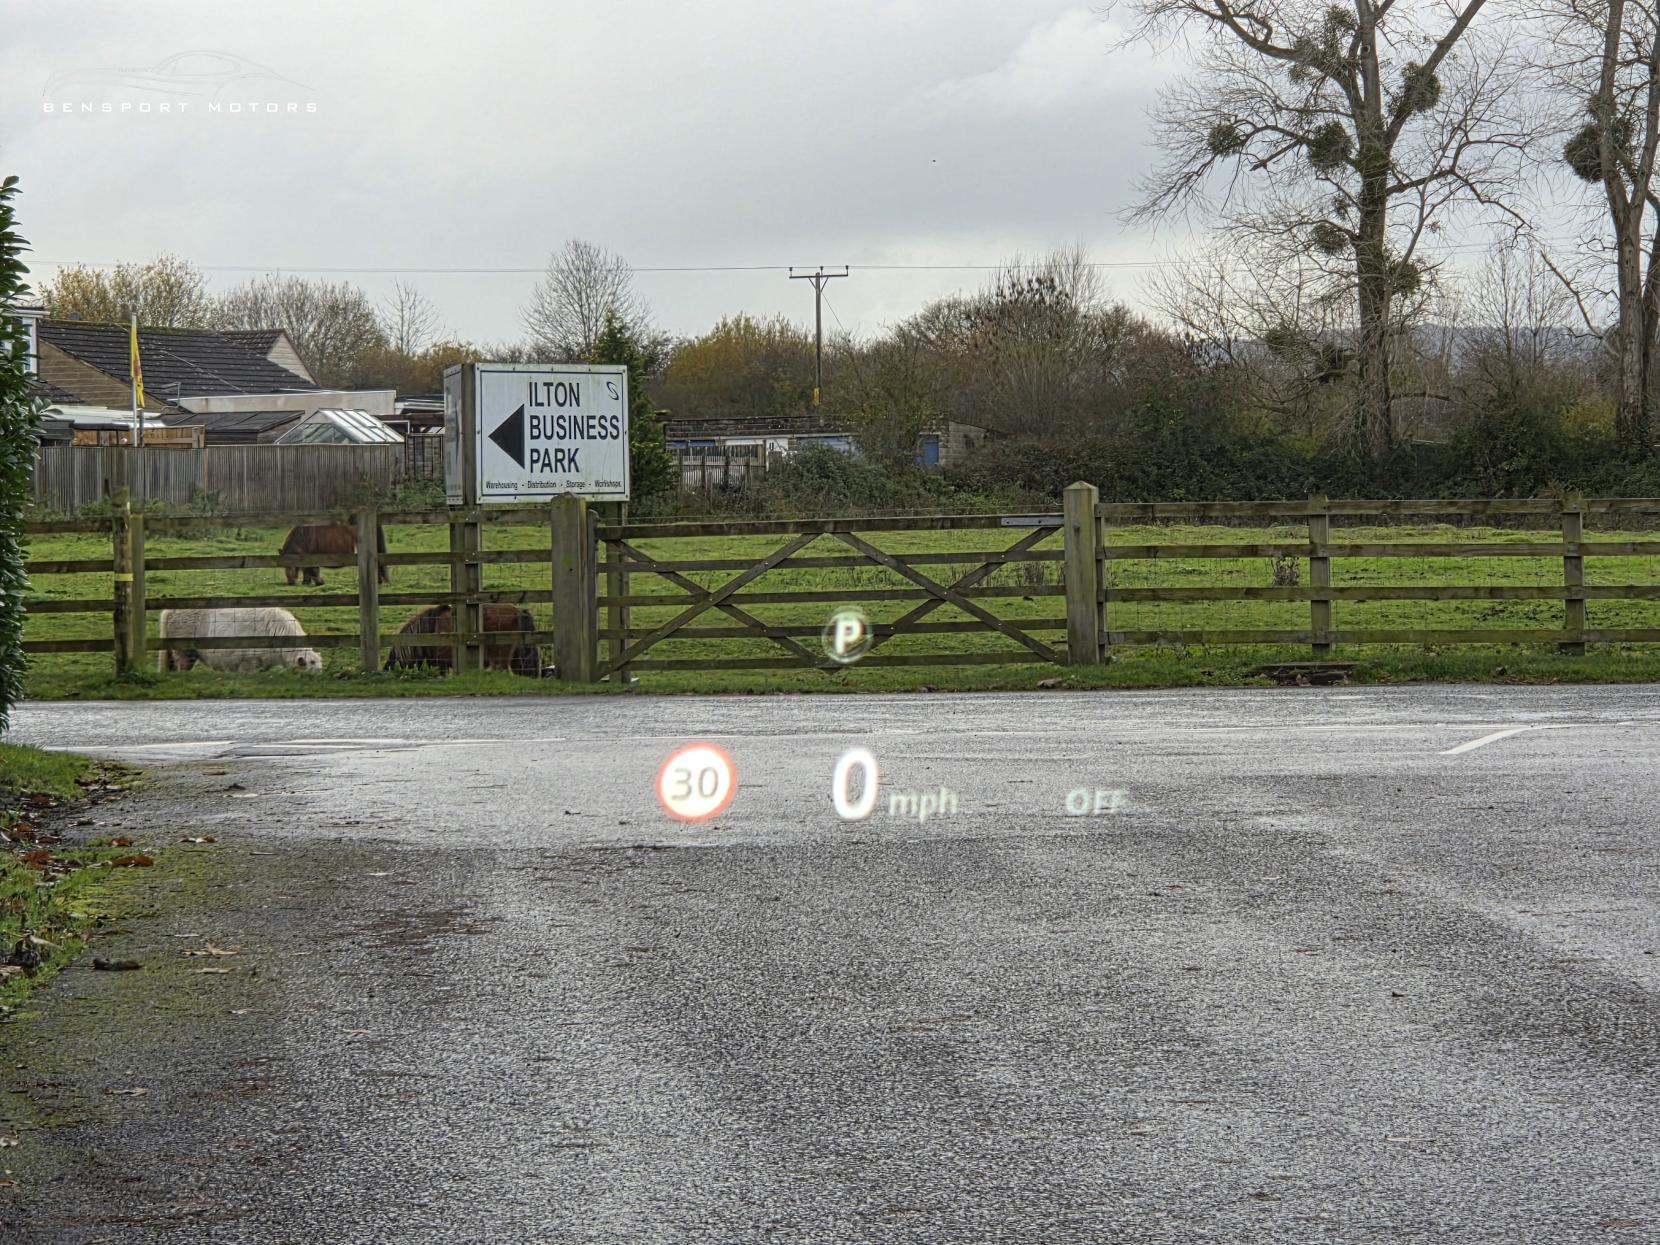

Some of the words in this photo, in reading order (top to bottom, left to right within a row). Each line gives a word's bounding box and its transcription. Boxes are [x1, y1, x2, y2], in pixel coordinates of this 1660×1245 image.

[529, 381, 581, 408] ILTON
[529, 414, 620, 441] BUSINESS
[529, 447, 580, 474] PARK
[486, 480, 518, 490] Warehousing
[527, 480, 557, 489] Distribution
[566, 480, 586, 490] Storage
[834, 617, 864, 654] P
[670, 766, 719, 800] 30
[832, 746, 879, 821] 0
[888, 785, 960, 822] mph
[1065, 787, 1130, 817] OFF
